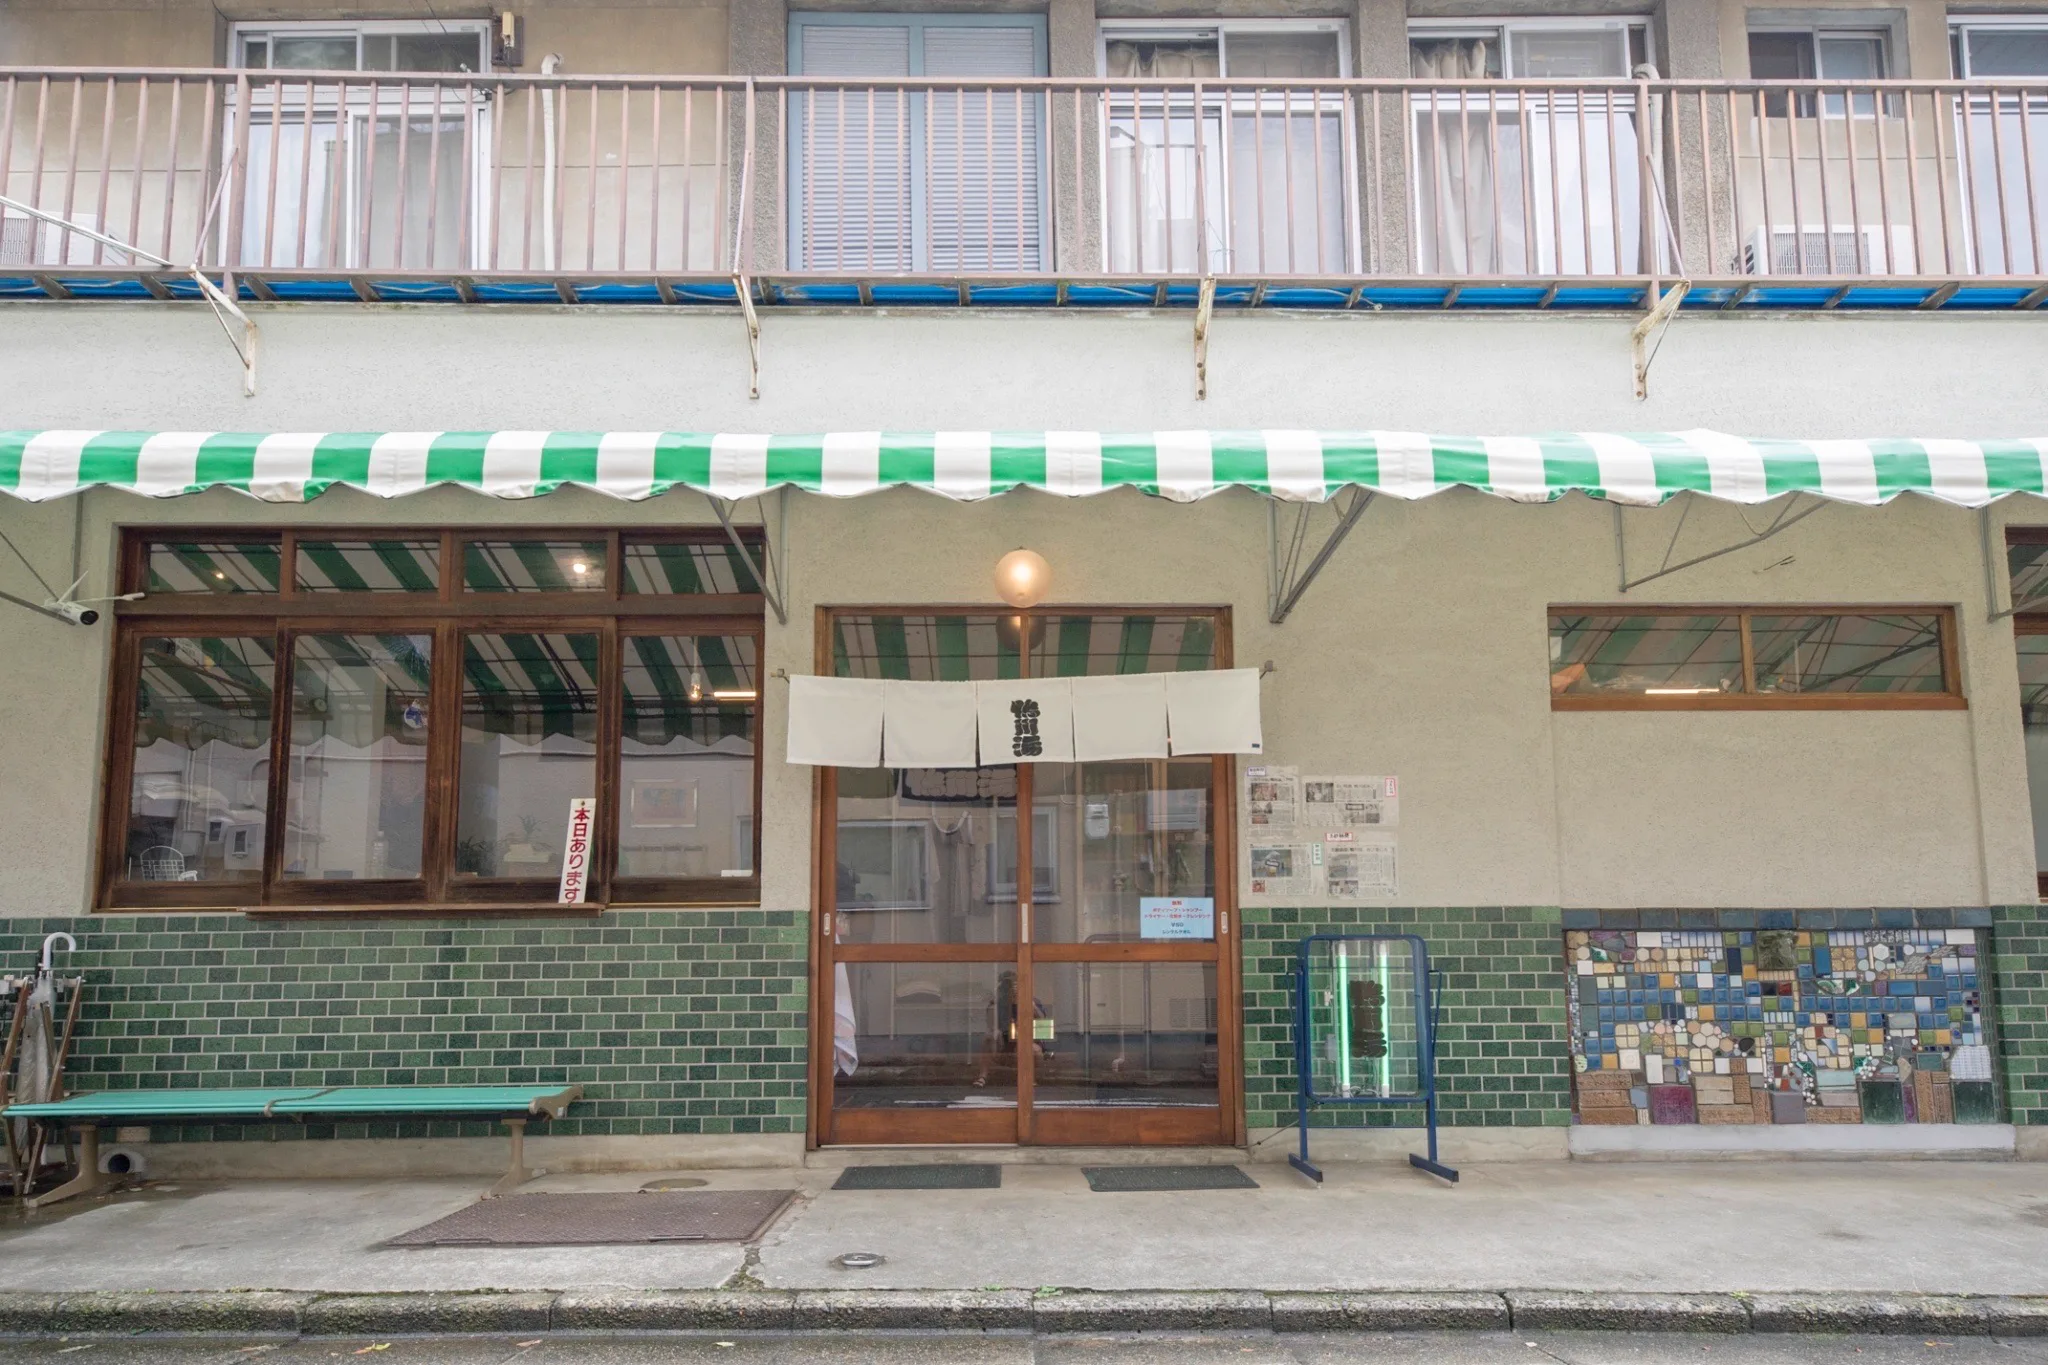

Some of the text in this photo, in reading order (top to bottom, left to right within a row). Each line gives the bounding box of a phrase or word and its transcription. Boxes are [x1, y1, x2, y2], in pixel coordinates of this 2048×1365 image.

[564, 807, 590, 904] 本日あります
